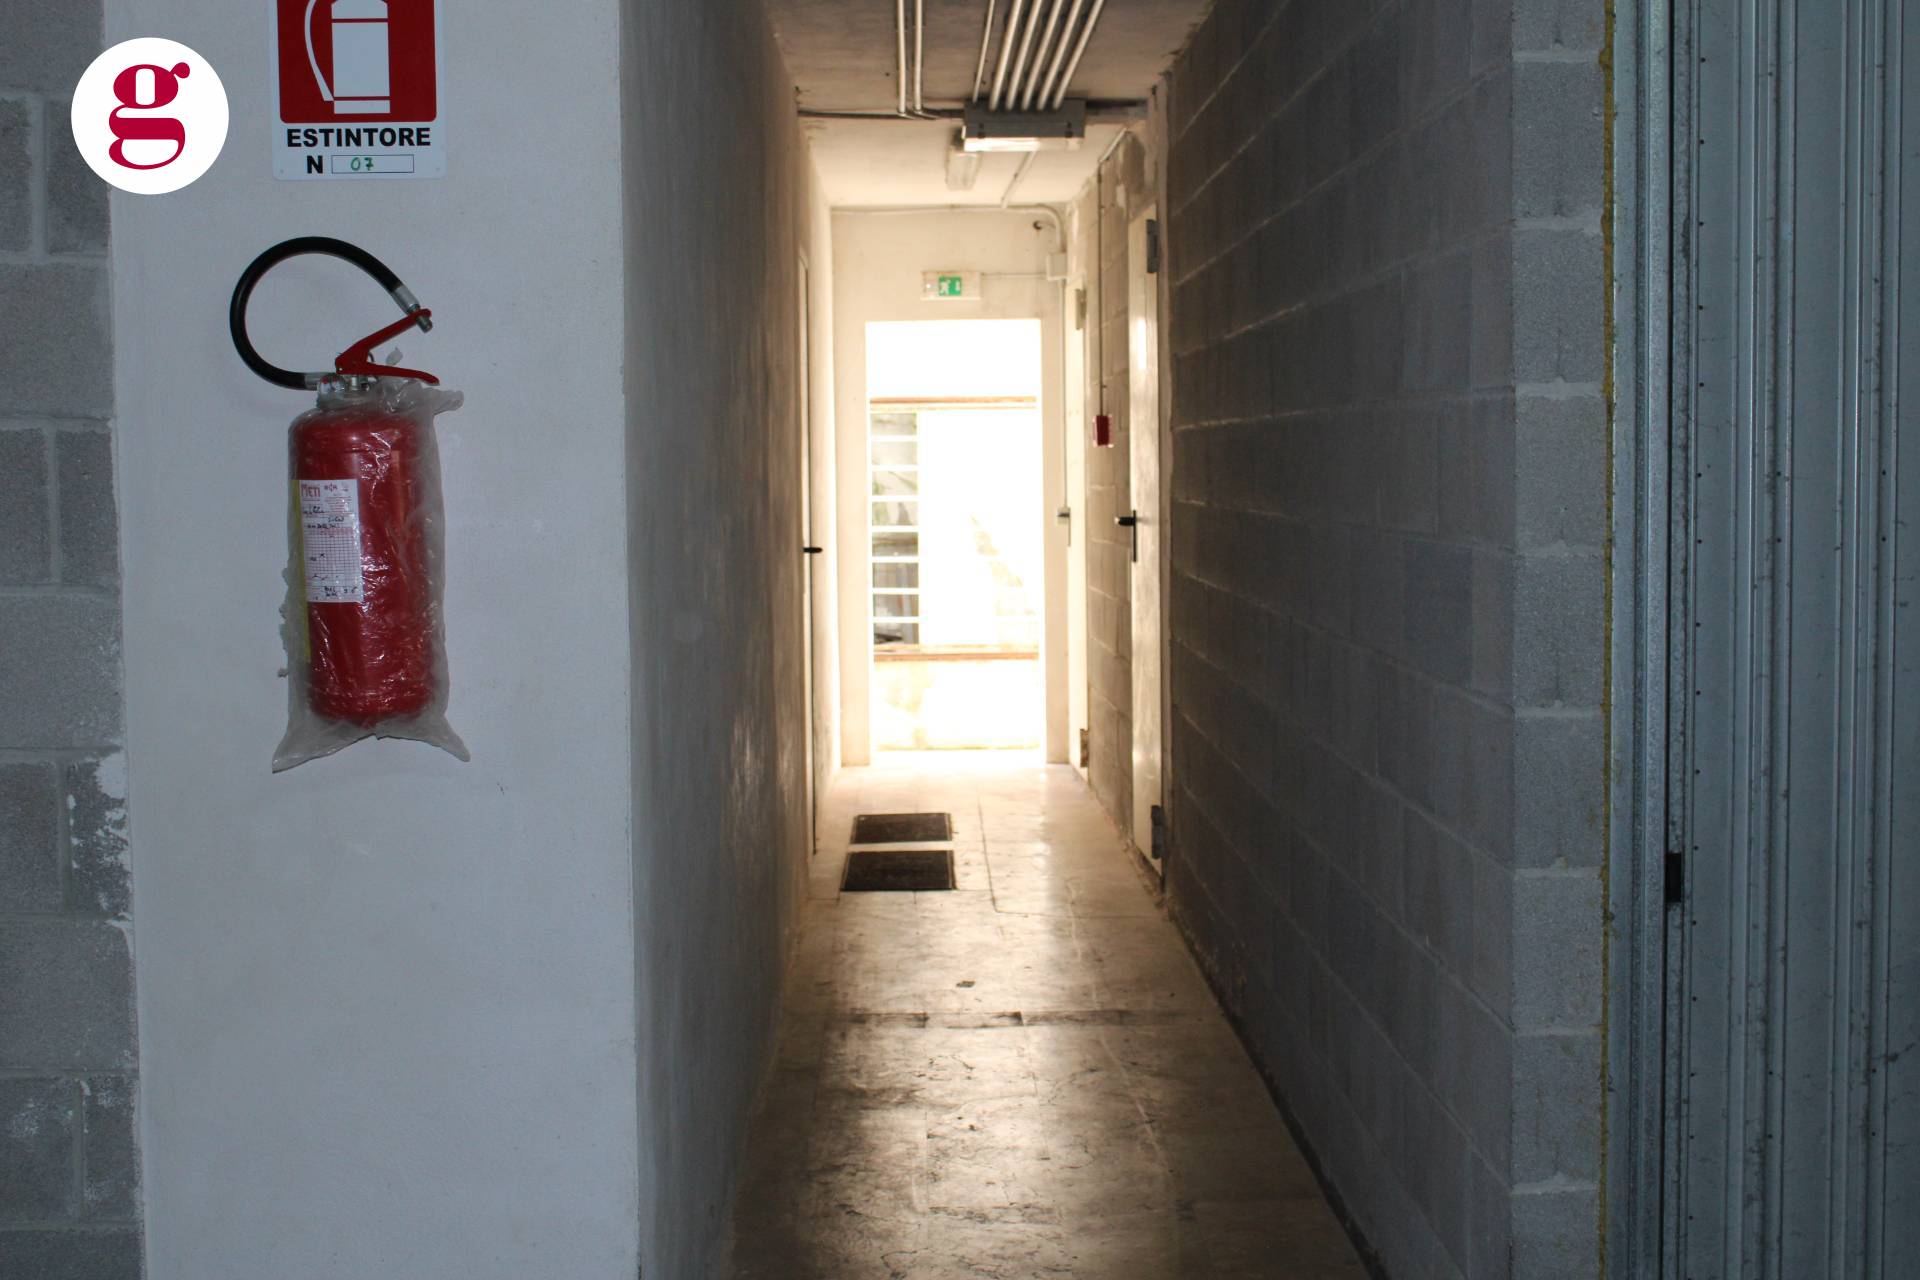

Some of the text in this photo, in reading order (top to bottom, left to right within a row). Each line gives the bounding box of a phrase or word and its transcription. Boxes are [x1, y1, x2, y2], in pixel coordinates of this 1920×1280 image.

[287, 127, 431, 148] ESTINTORE
[306, 155, 374, 174] N 07
